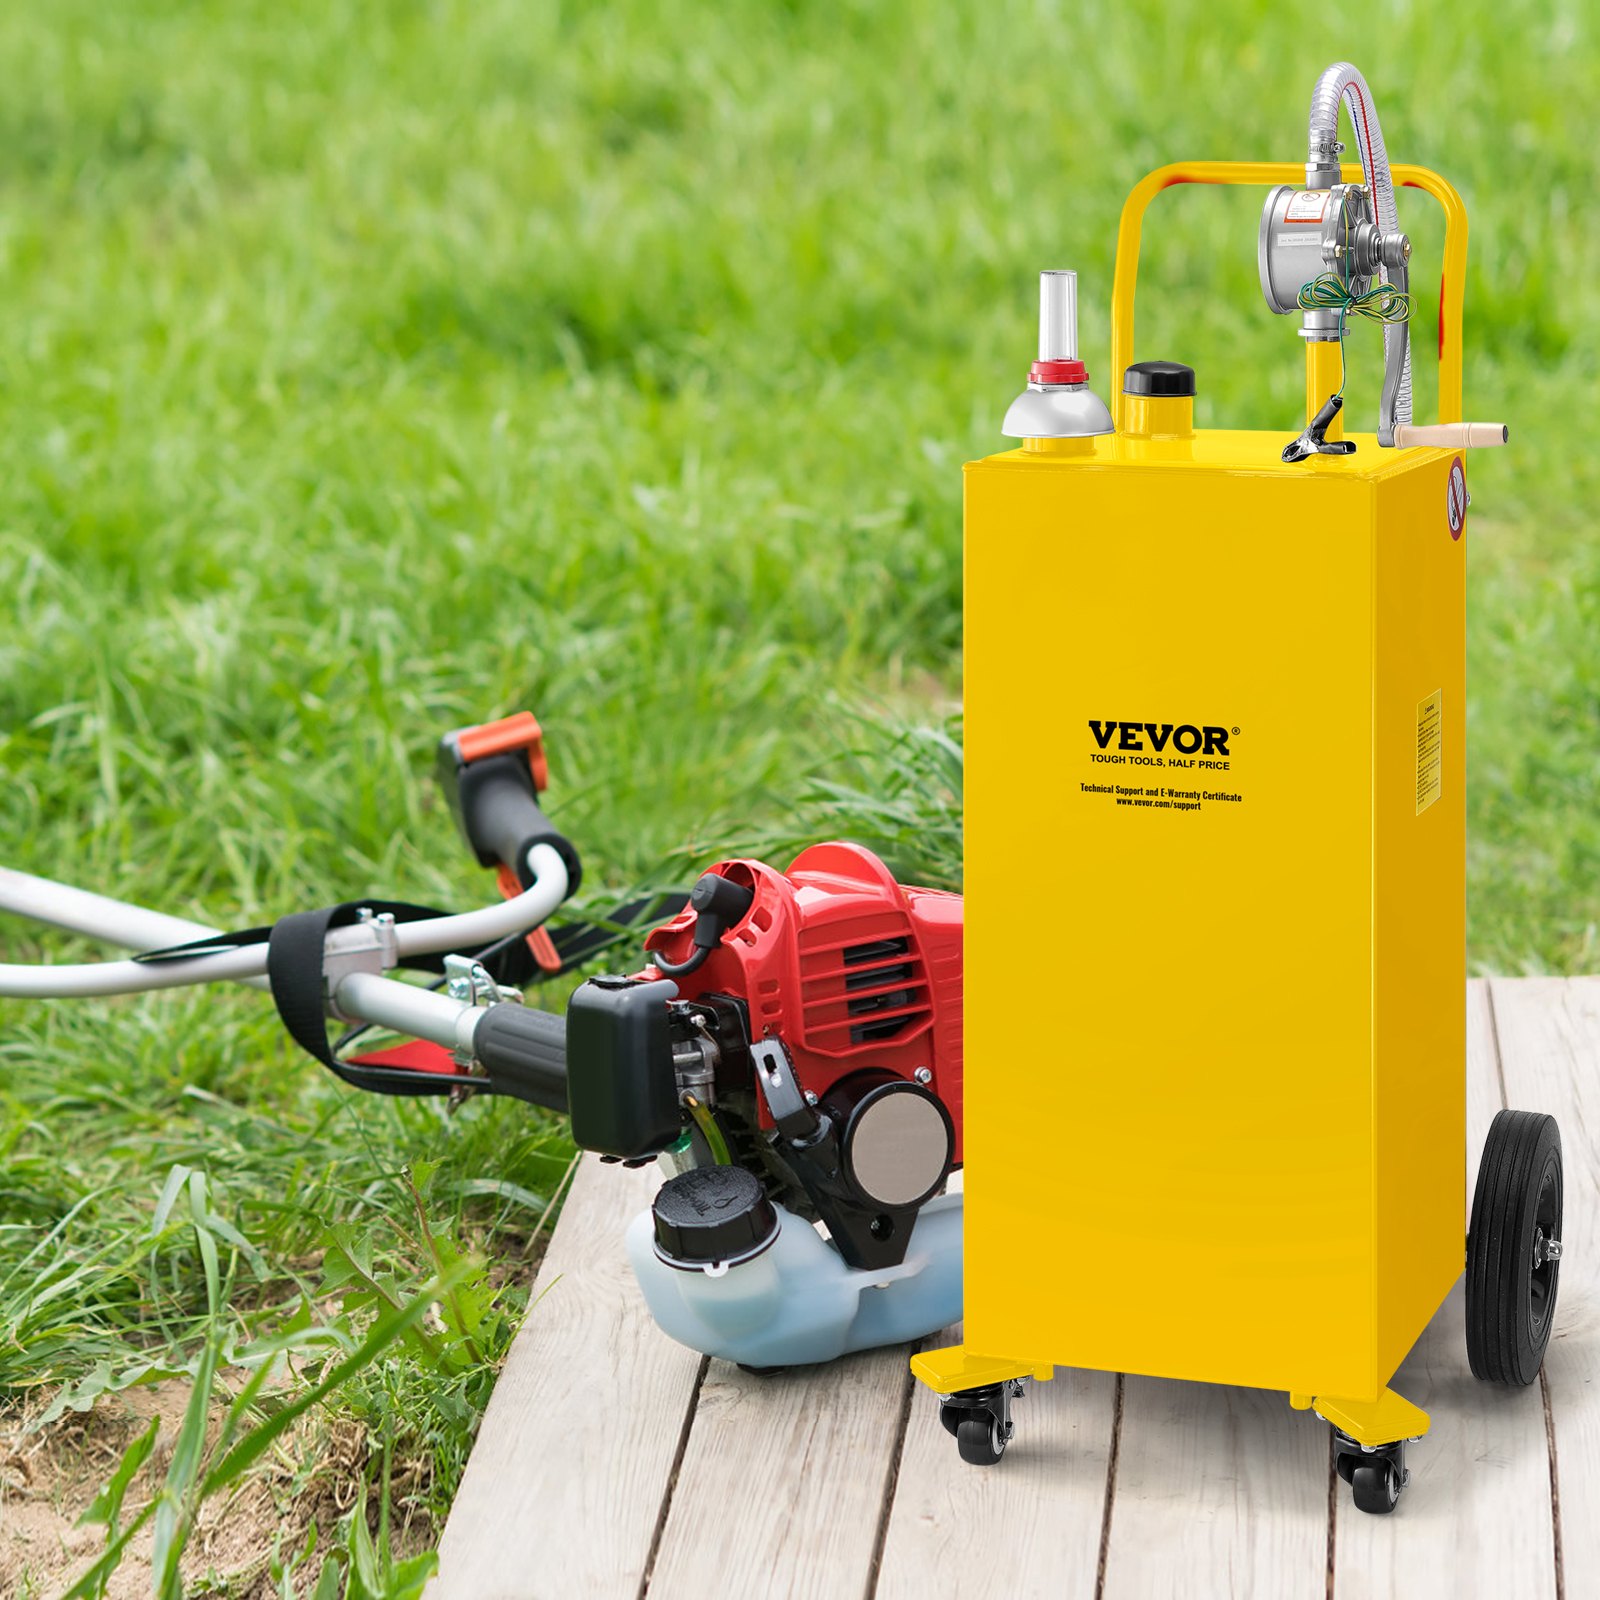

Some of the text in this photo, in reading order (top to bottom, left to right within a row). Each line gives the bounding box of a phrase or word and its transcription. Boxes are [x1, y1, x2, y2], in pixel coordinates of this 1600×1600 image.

[1089, 720, 1230, 756] VEVOR
[1090, 754, 1231, 771] TOUGH TOOLS, HALF PRICE
[1080, 783, 1242, 802] Technical Support and E-Warranty Certificate
[1116, 797, 1202, 811] www.vevor.com/support
